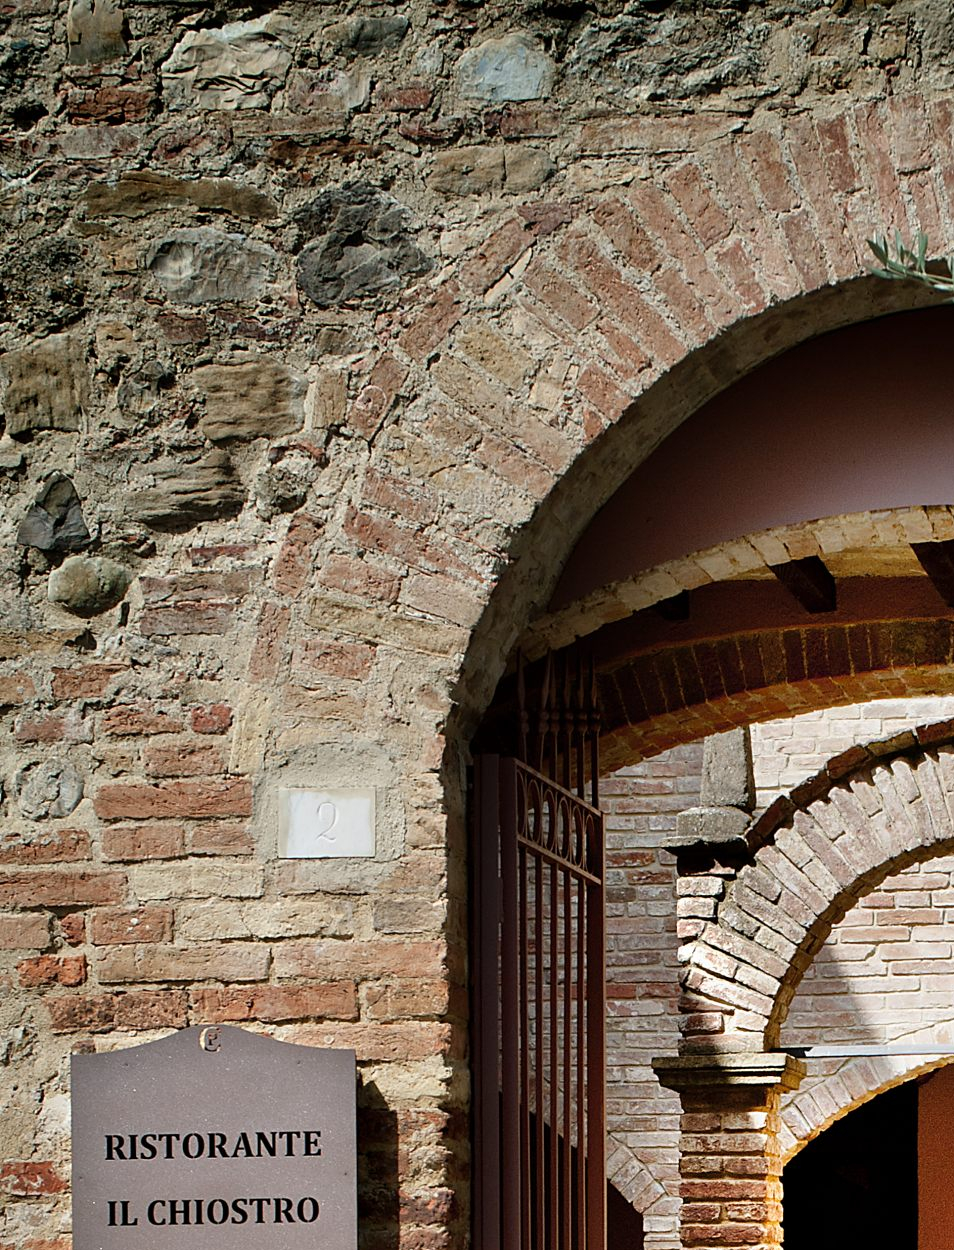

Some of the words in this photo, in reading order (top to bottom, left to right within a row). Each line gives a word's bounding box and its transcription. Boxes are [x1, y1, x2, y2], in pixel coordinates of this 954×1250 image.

[316, 801, 337, 842] 2
[104, 1131, 322, 1160] RISTORANTE
[107, 1200, 138, 1226] IL
[147, 1197, 320, 1225] CHIOSTRO
